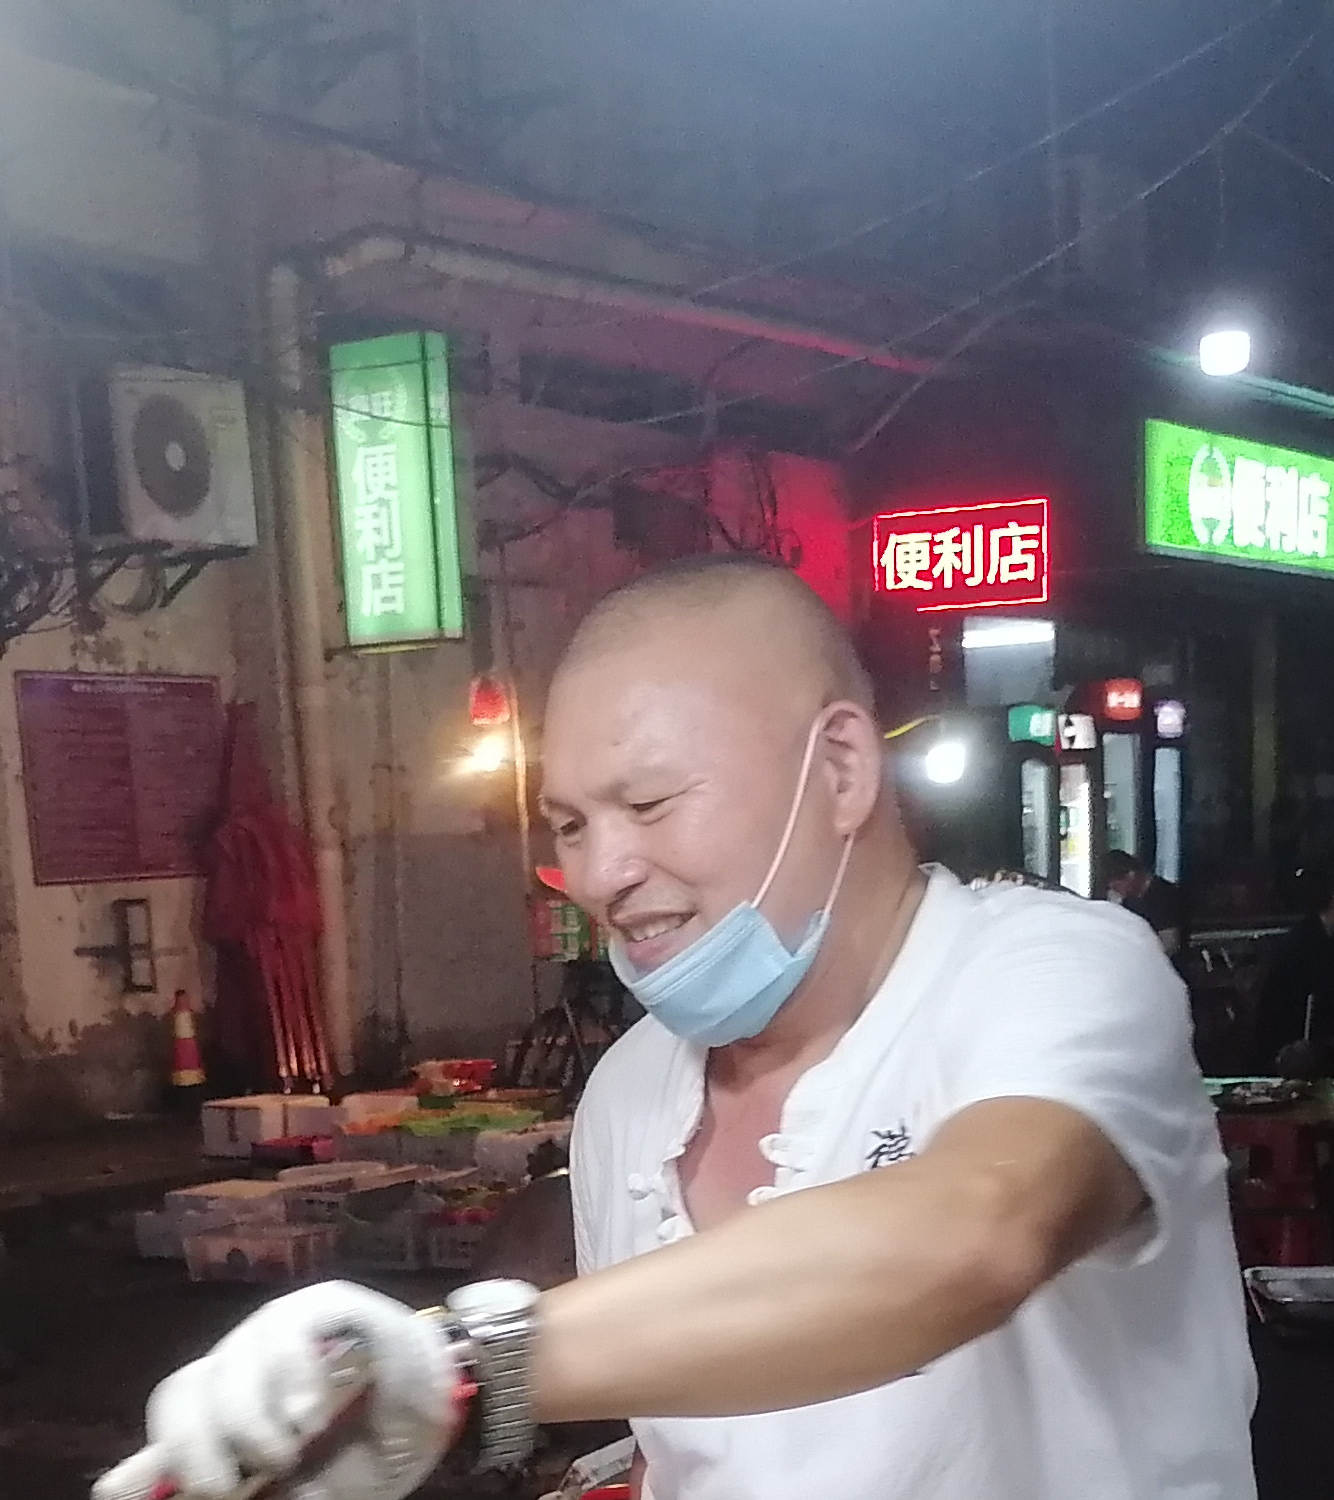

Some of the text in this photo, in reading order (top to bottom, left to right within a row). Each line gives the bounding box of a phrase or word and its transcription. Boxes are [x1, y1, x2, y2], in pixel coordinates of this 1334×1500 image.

[350, 443, 405, 617] 便利店
[880, 521, 1041, 591] 便利店
[1231, 455, 1331, 558] 便利店
